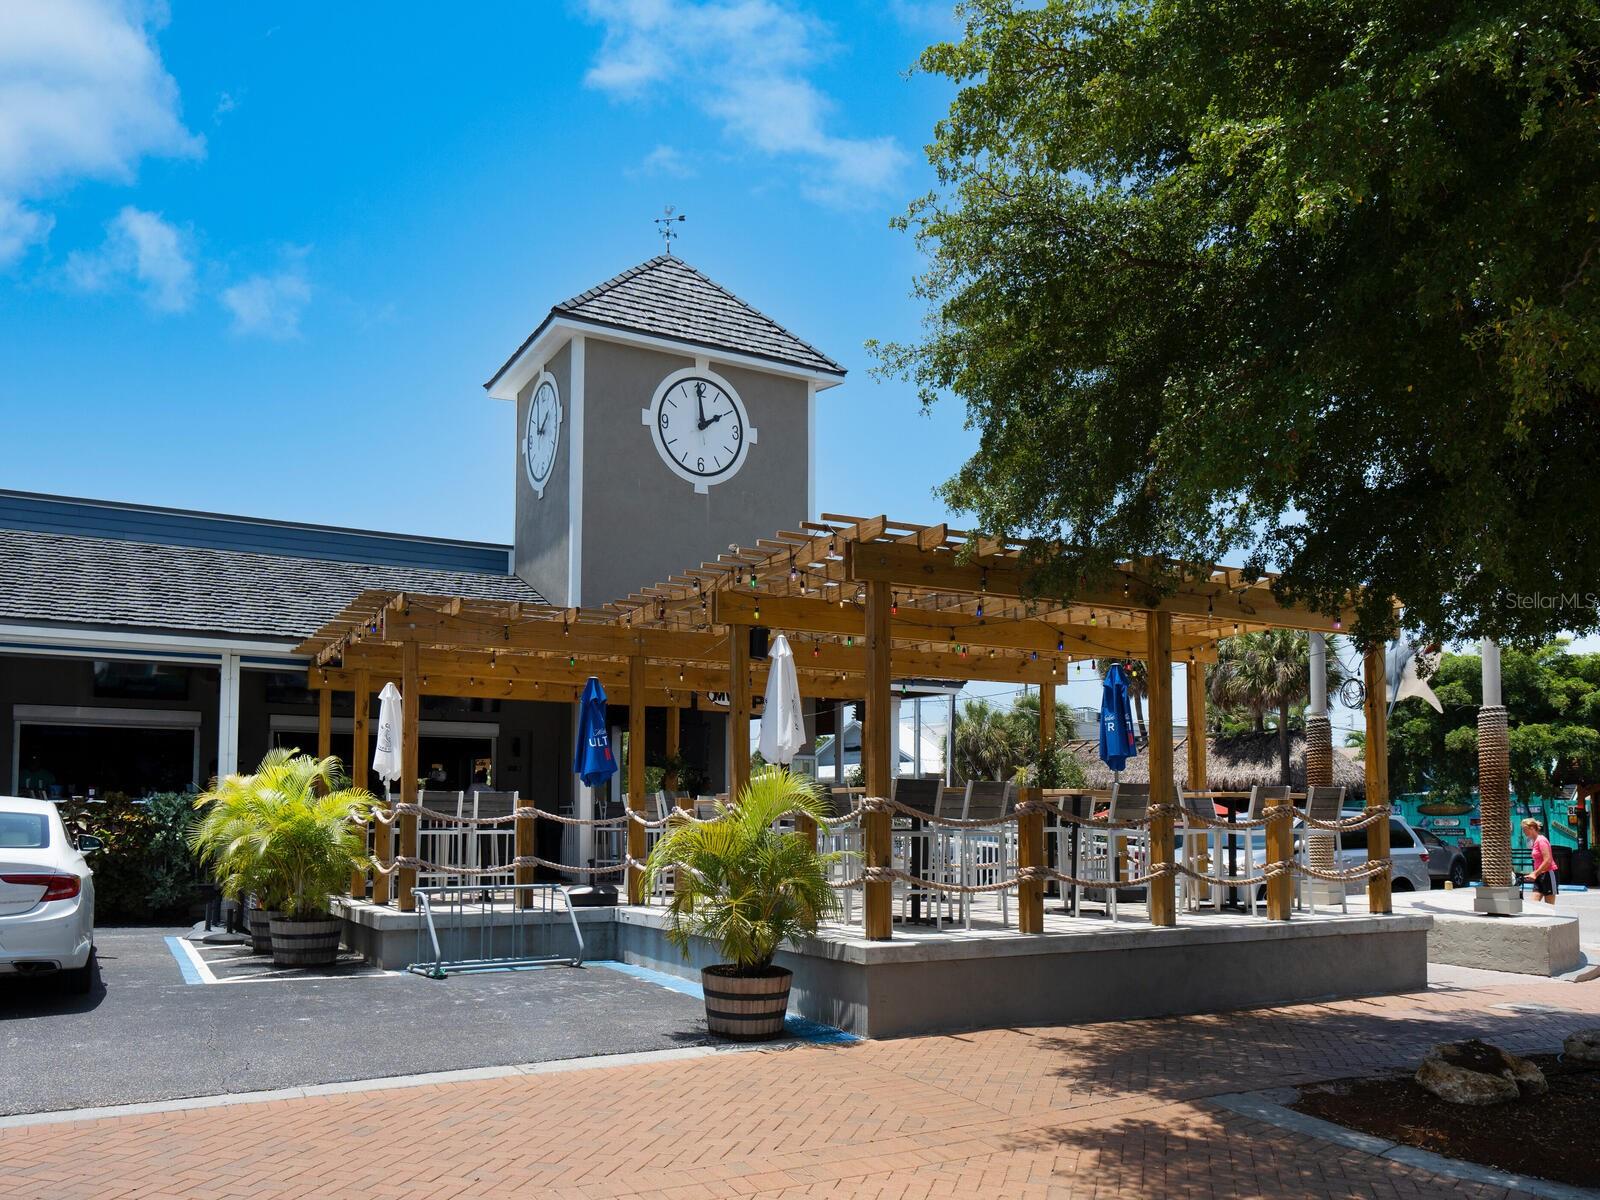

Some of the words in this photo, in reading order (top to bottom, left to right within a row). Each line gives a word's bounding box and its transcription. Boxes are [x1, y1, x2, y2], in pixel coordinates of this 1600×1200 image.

[661, 413, 669, 429] 9
[731, 424, 739, 441] 3
[697, 457, 705, 473] 6
